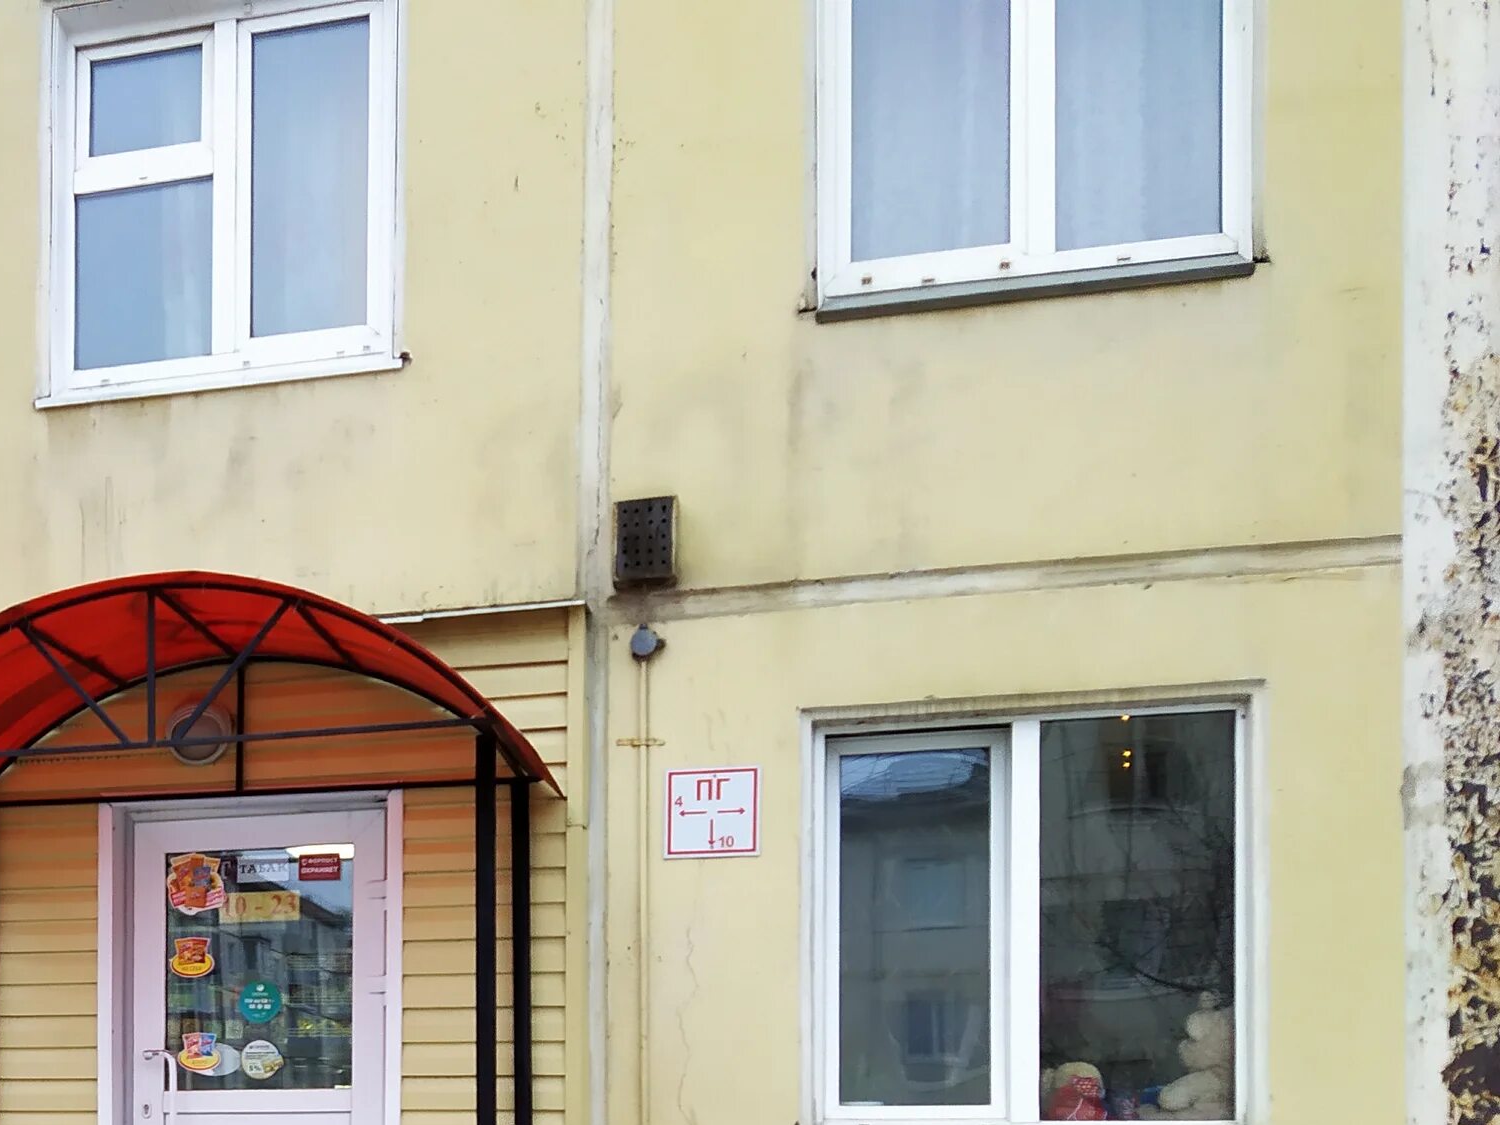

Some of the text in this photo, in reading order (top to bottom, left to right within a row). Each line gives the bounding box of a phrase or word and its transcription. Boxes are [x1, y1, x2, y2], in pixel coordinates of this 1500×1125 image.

[696, 778, 731, 801] ПГ
[674, 796, 684, 807] 4
[718, 836, 735, 848] 10
[240, 863, 288, 874] ТАБАК
